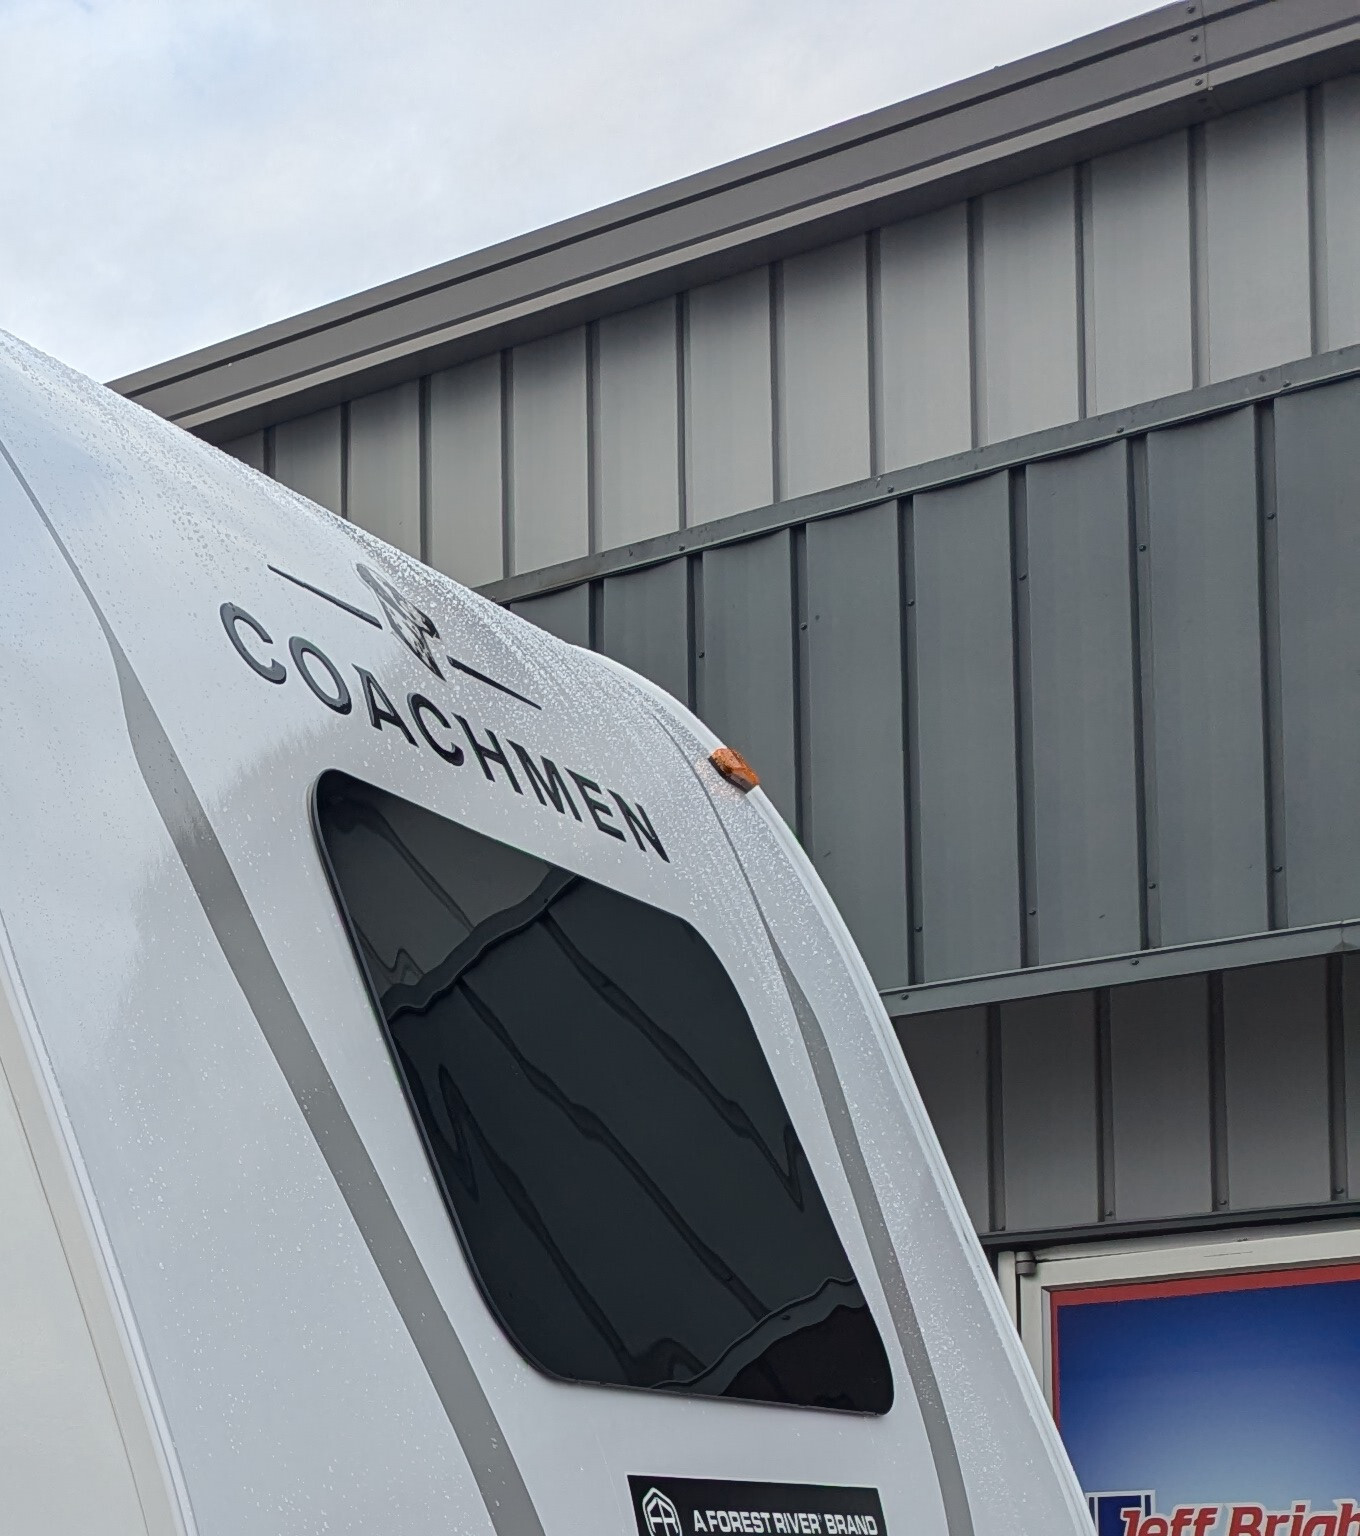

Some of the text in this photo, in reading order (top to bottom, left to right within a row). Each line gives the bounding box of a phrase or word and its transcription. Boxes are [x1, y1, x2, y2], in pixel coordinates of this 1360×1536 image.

[219, 602, 671, 864] COACHMEN
[693, 1510, 707, 1532] A
[706, 1510, 772, 1533] FOREST
[826, 1514, 878, 1535] BRAND
